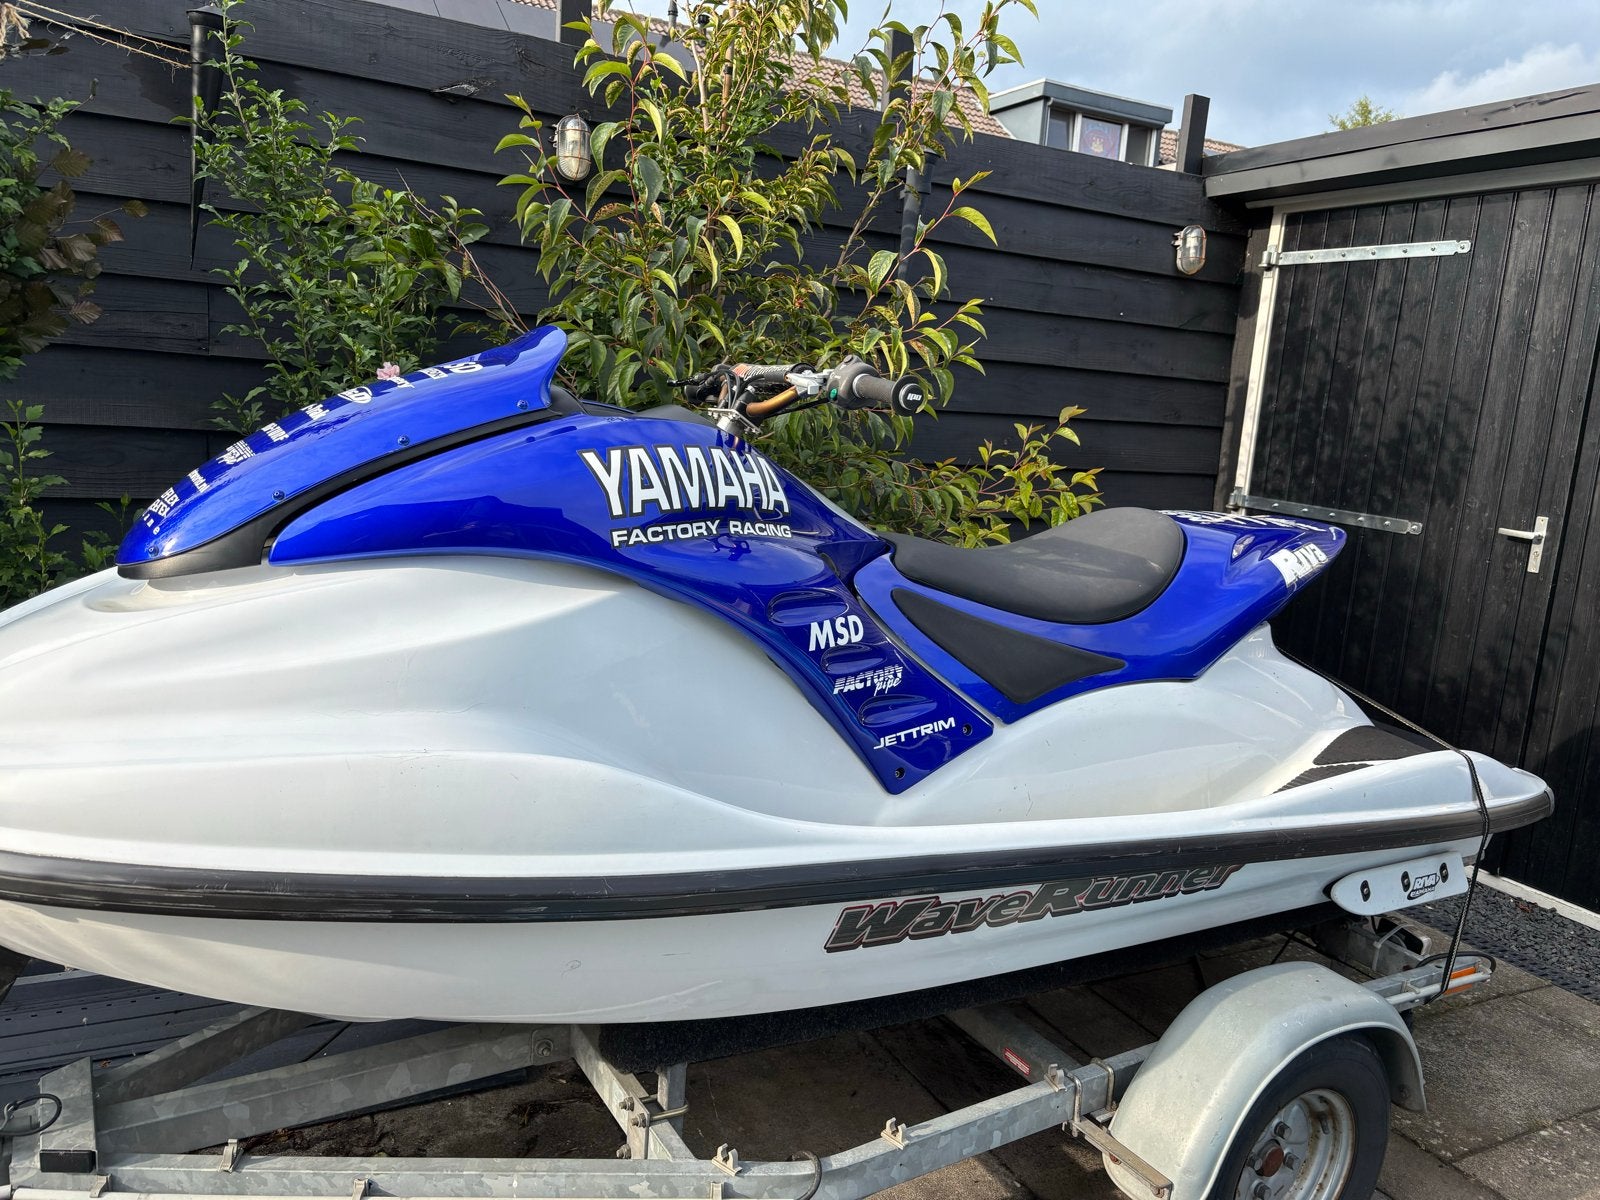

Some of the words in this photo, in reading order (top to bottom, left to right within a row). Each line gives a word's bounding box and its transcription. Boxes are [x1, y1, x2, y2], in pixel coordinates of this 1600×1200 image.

[578, 445, 790, 518] YAMAHA
[611, 518, 721, 548] FACTORY
[728, 519, 793, 539] RACING
[808, 614, 864, 652] MSD
[833, 664, 904, 695] FACTORY
[873, 717, 956, 750] JETTRIM
[824, 863, 1243, 954] WaveRunner
